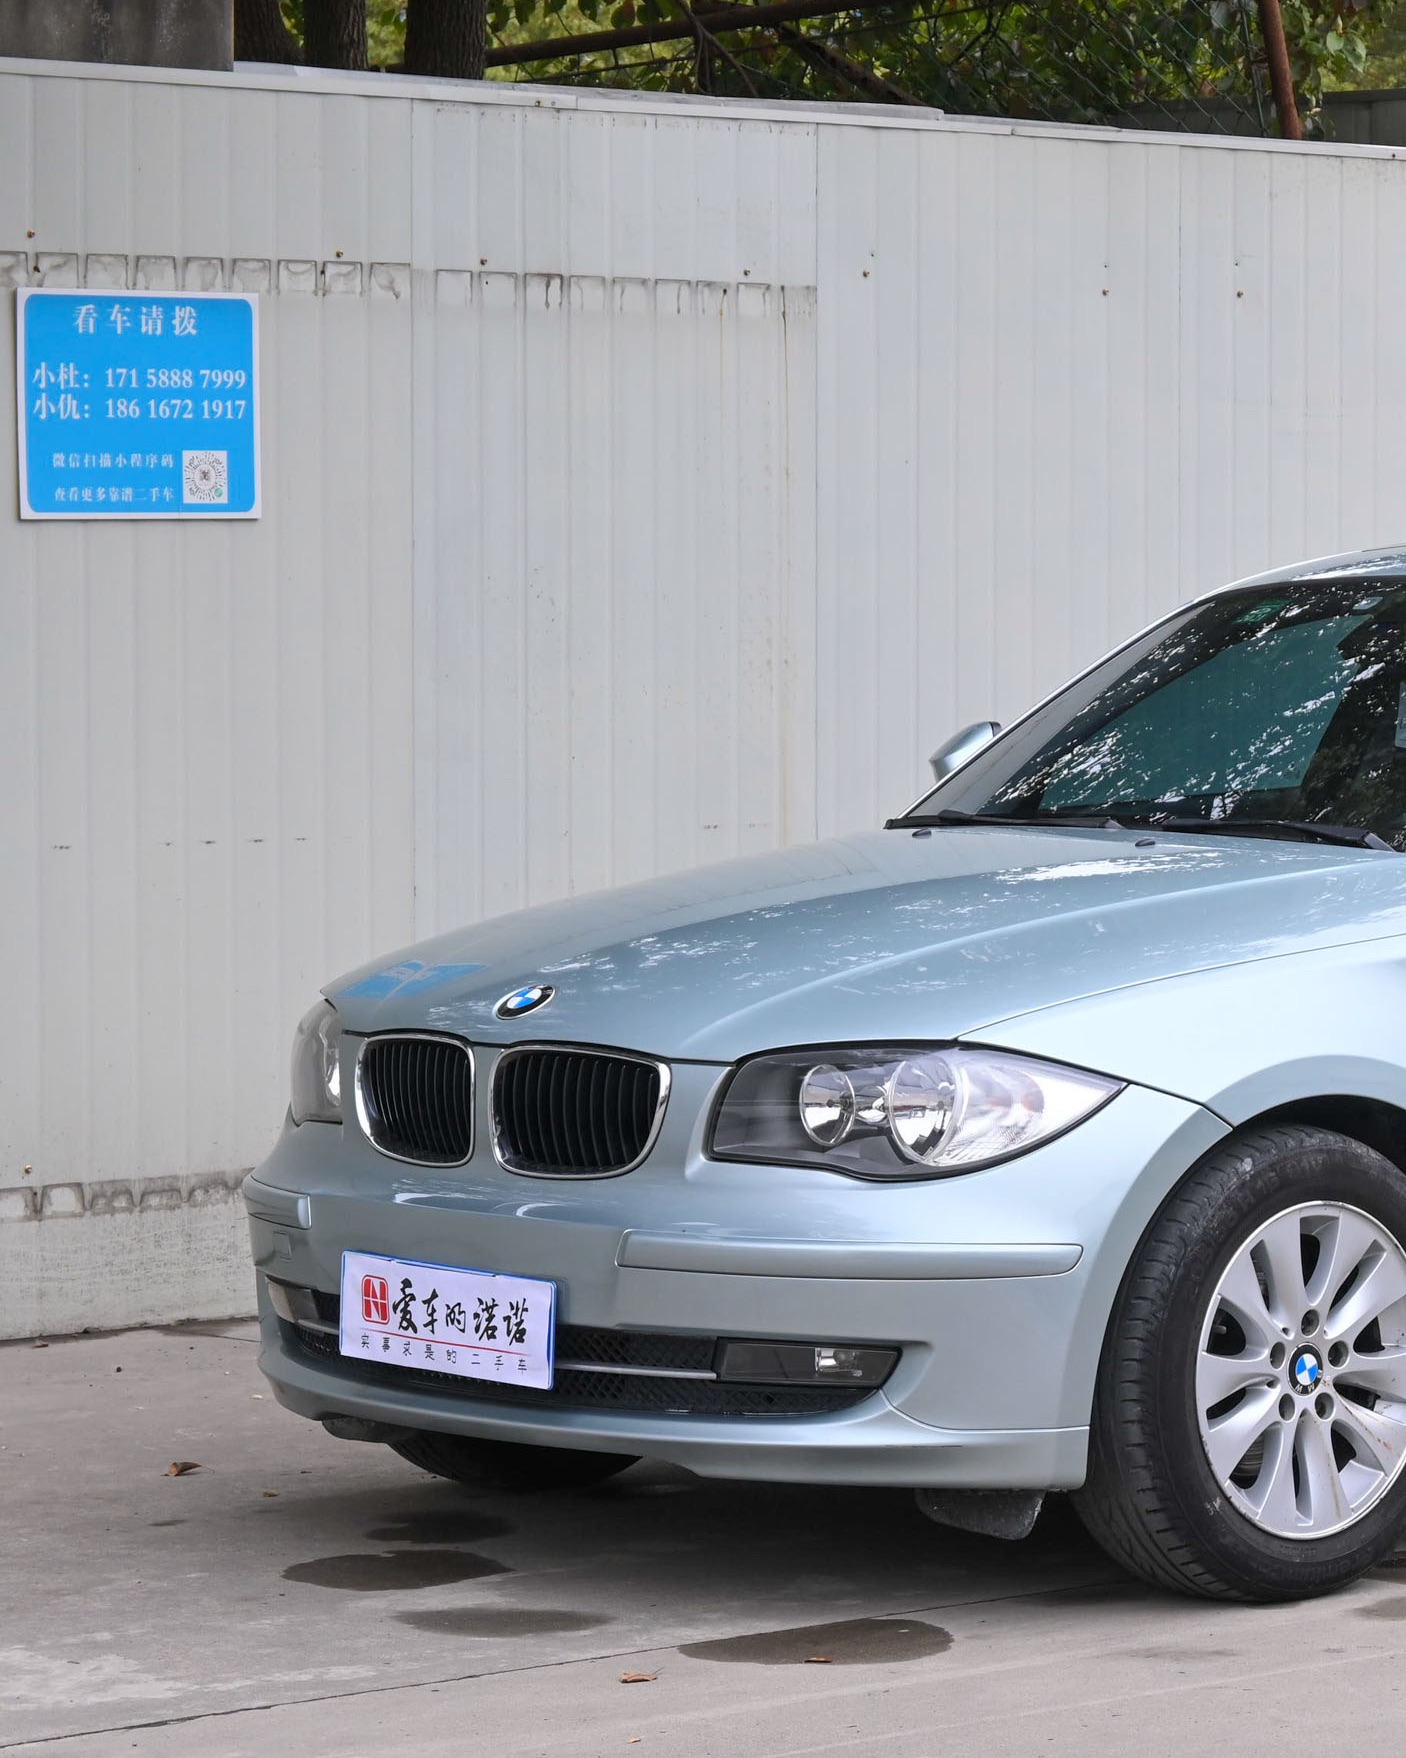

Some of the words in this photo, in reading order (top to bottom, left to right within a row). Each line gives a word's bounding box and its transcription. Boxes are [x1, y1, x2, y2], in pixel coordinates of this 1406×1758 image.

[73, 304, 199, 336] 看车请拨
[105, 368, 139, 388] 171
[147, 369, 193, 388] 5888
[201, 369, 246, 388] 7999
[106, 399, 140, 418] 186
[149, 399, 194, 418] 1672
[202, 399, 247, 419] 1917
[53, 452, 174, 469] 微信扫描小程序码
[55, 487, 174, 502] 查看更多靠谱二手车
[392, 1277, 529, 1346] 爱车的诺诺
[360, 1332, 528, 1374] 实事求是的二手车
